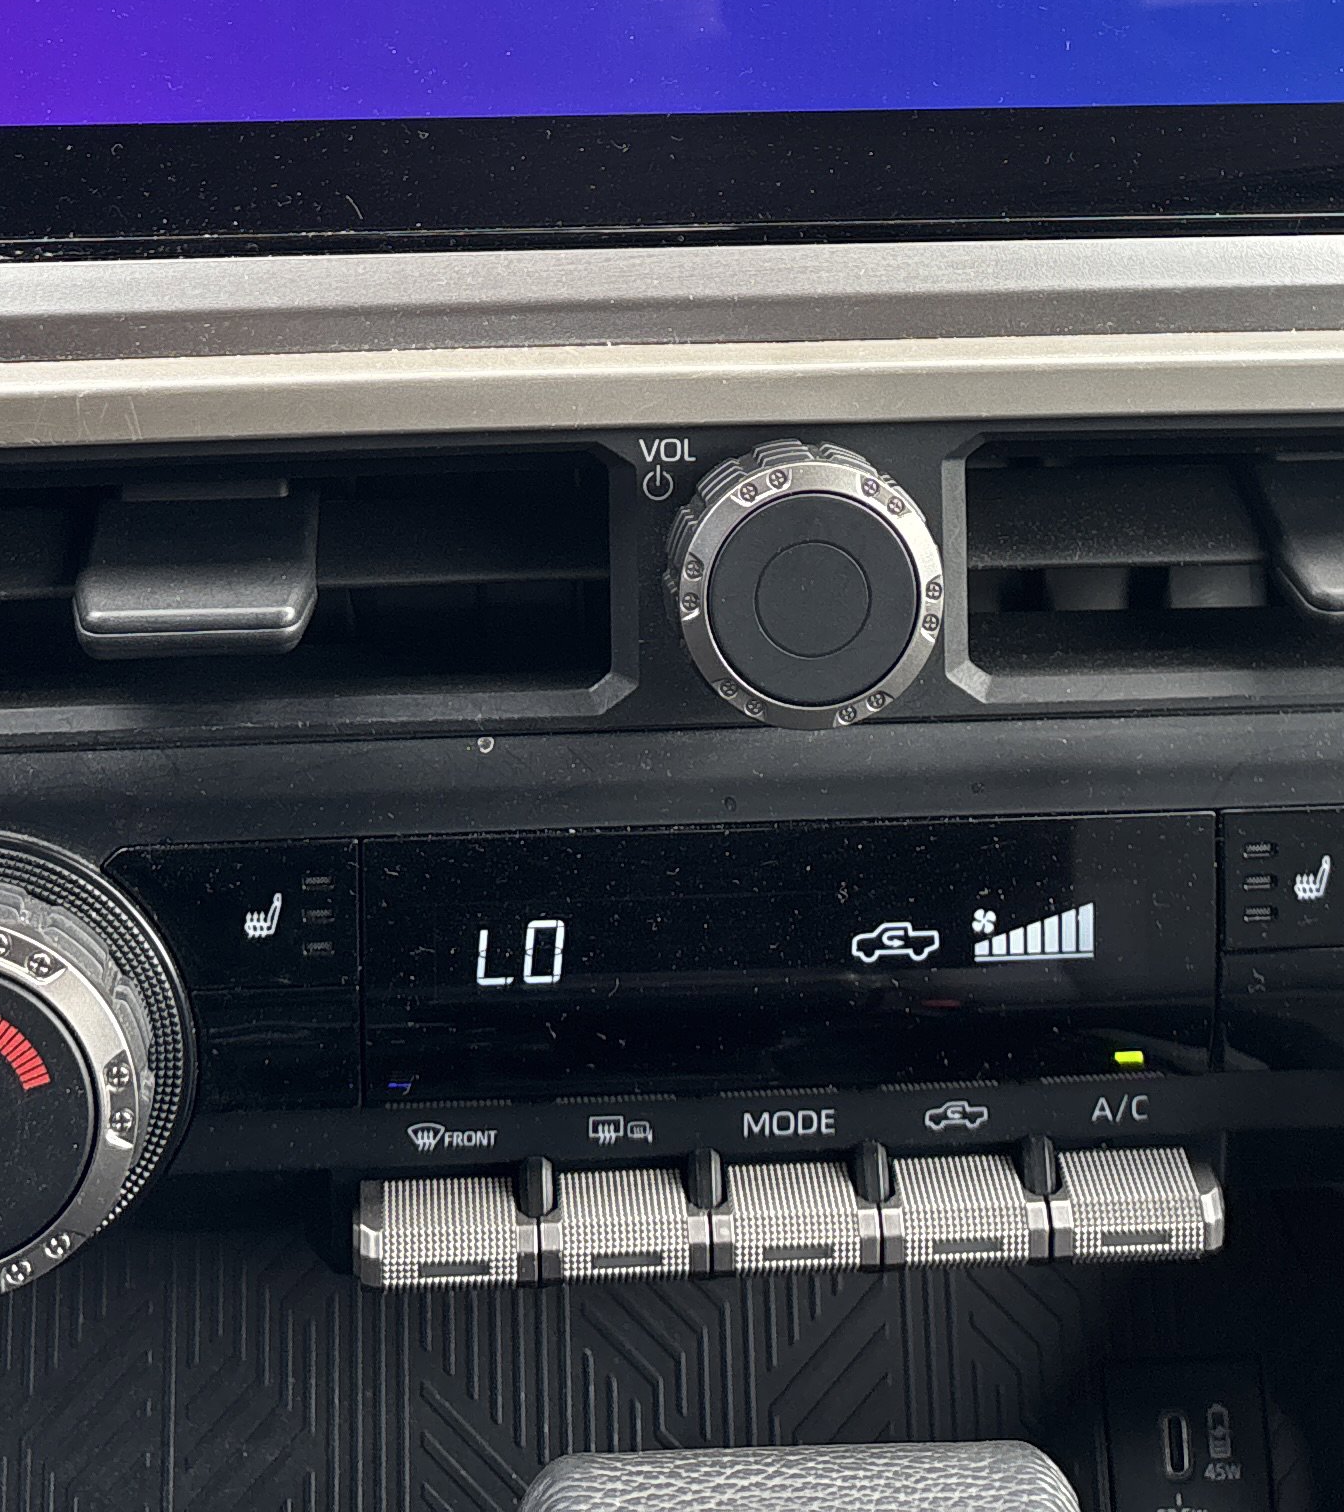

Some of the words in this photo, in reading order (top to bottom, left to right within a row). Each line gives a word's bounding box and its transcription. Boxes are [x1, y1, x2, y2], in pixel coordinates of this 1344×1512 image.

[639, 439, 696, 462] VOL
[1091, 1094, 1150, 1123] A/C
[743, 1109, 836, 1138] MODE
[444, 1130, 498, 1148] FRONT
